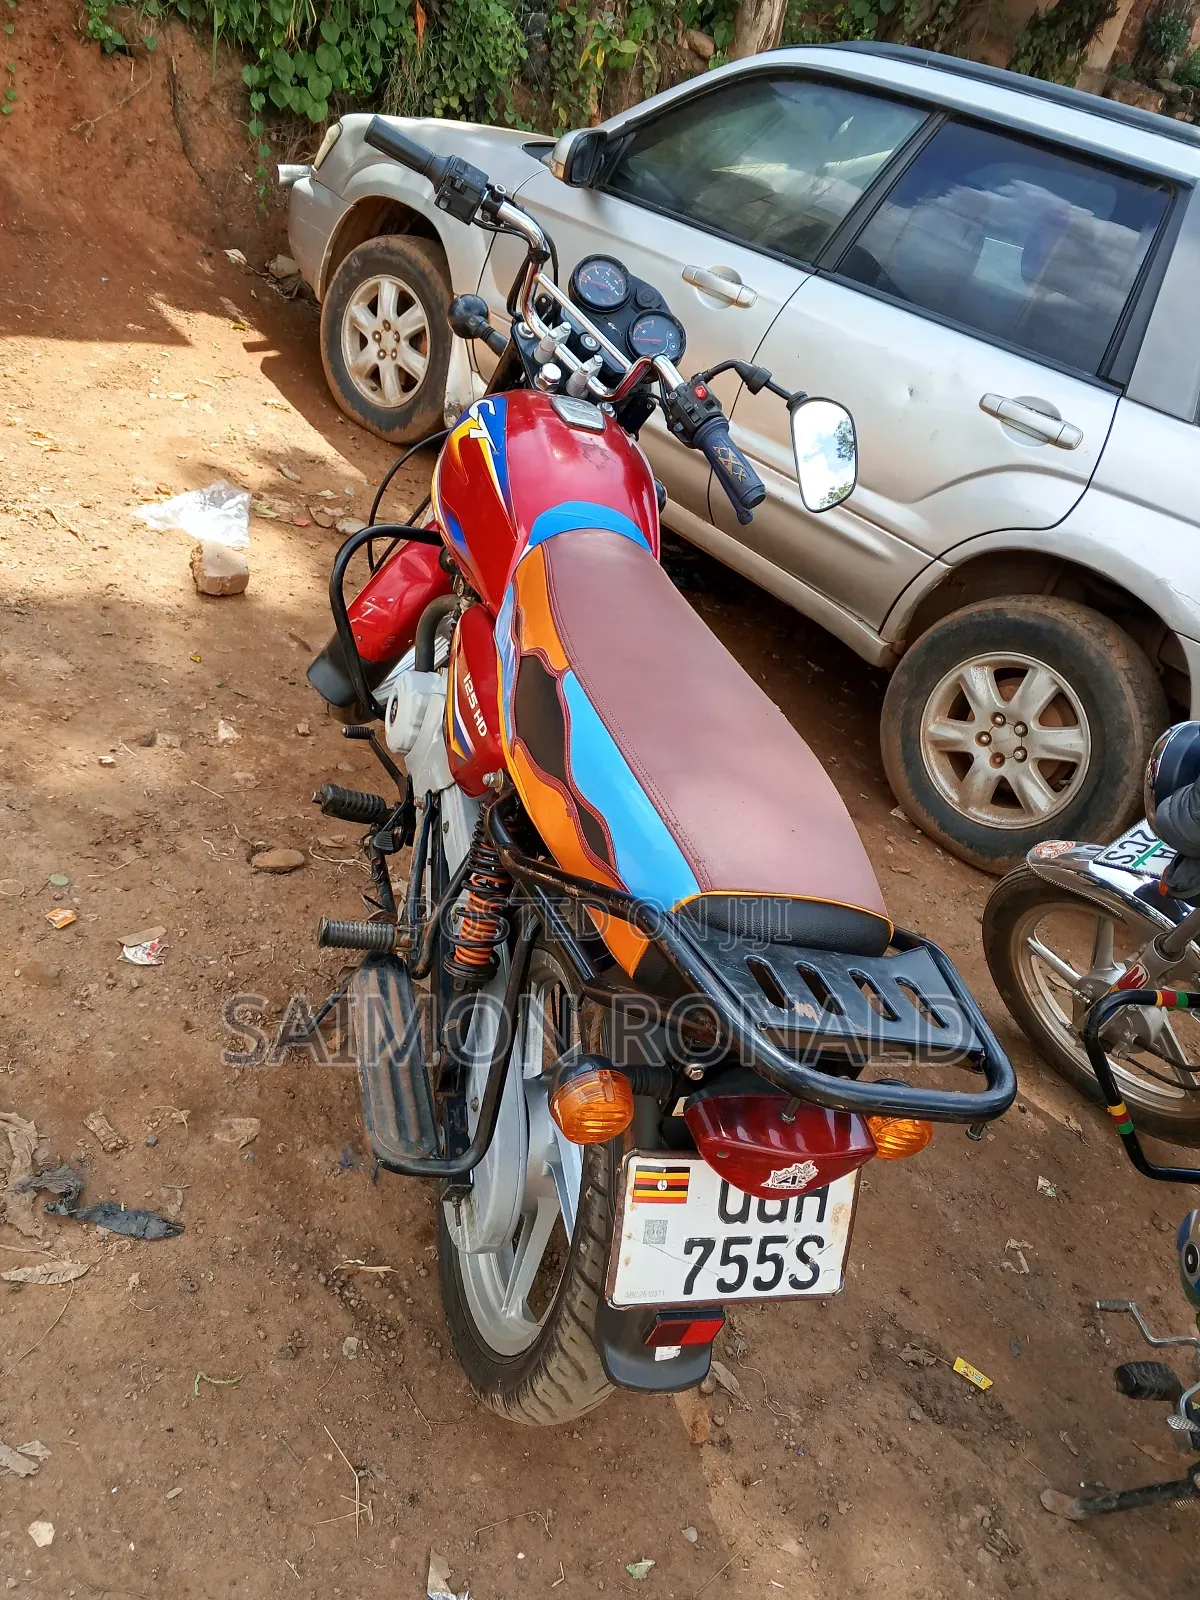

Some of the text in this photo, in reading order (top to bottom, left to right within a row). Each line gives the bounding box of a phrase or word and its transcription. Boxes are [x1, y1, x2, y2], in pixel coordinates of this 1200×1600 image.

[463, 672, 488, 737] 125 HD
[682, 1234, 825, 1296] 755S
